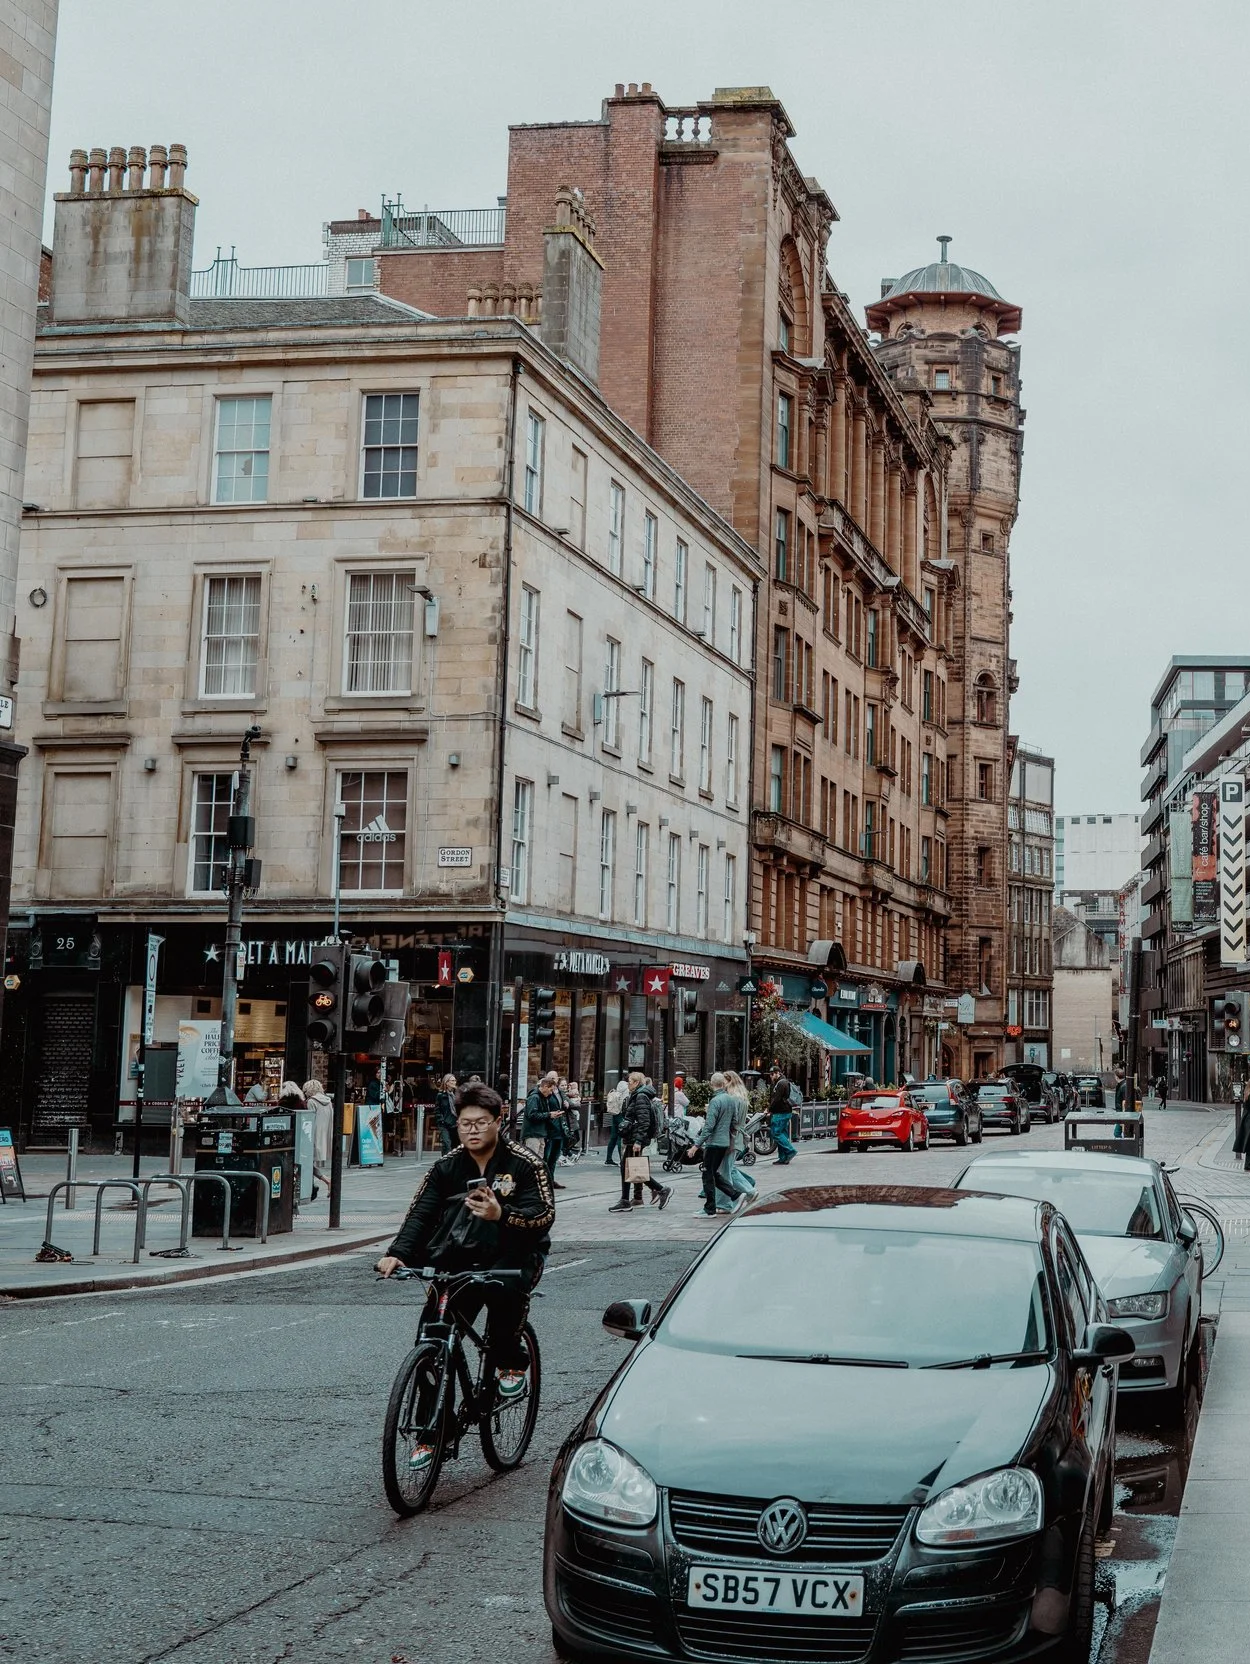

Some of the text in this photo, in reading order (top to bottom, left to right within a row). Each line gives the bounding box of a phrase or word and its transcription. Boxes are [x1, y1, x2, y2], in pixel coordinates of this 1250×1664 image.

[1226, 783, 1239, 801] P
[356, 832, 397, 843] adidas
[1199, 802, 1210, 867] café bar/shop
[56, 937, 75, 950] 25
[268, 940, 279, 965] A
[672, 962, 710, 980] GREAVES
[702, 1573, 851, 1610] SB57 VCX
